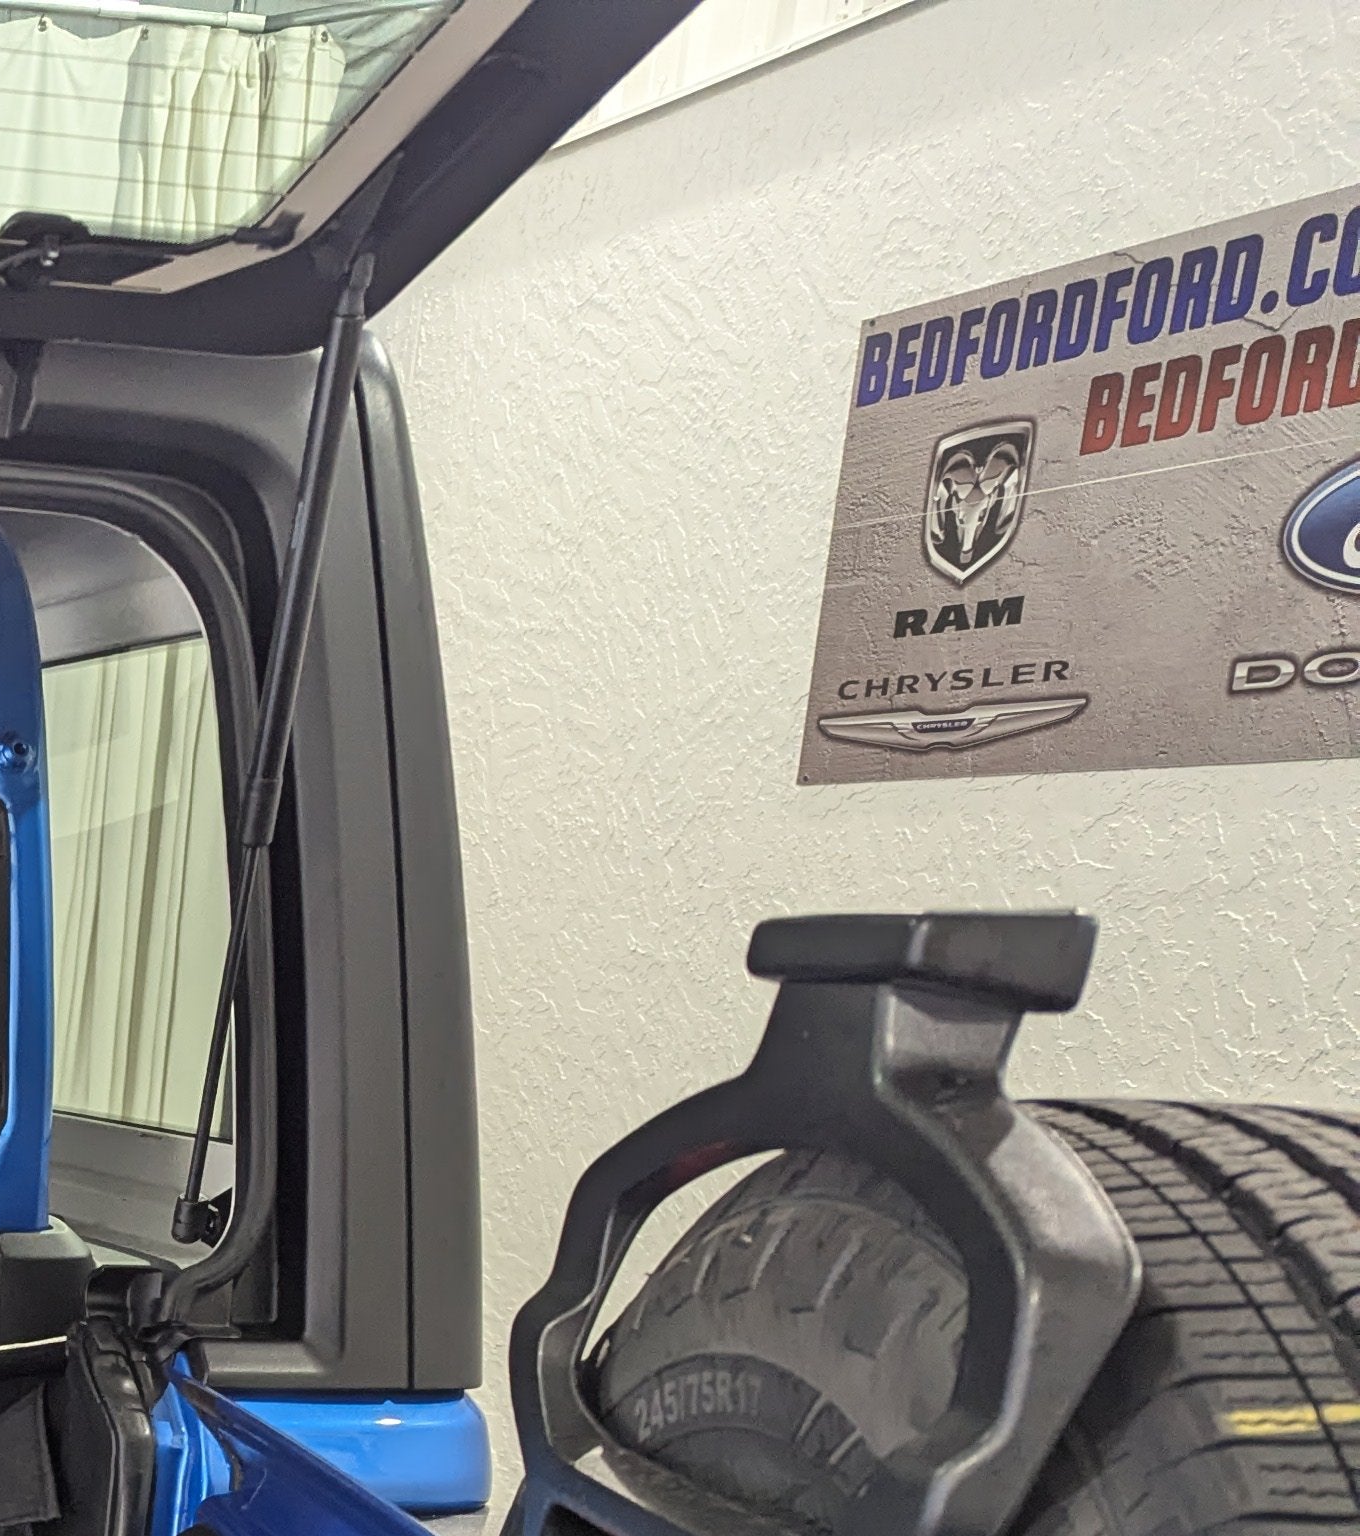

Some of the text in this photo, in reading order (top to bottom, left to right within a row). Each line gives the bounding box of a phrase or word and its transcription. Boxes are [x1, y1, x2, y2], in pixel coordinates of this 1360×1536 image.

[893, 595, 1025, 638] RAM
[837, 660, 1070, 700] CHRYSLER
[1231, 651, 1360, 691] DO
[916, 720, 968, 730] CHRYSLER
[634, 1369, 763, 1444] 245/75R17
